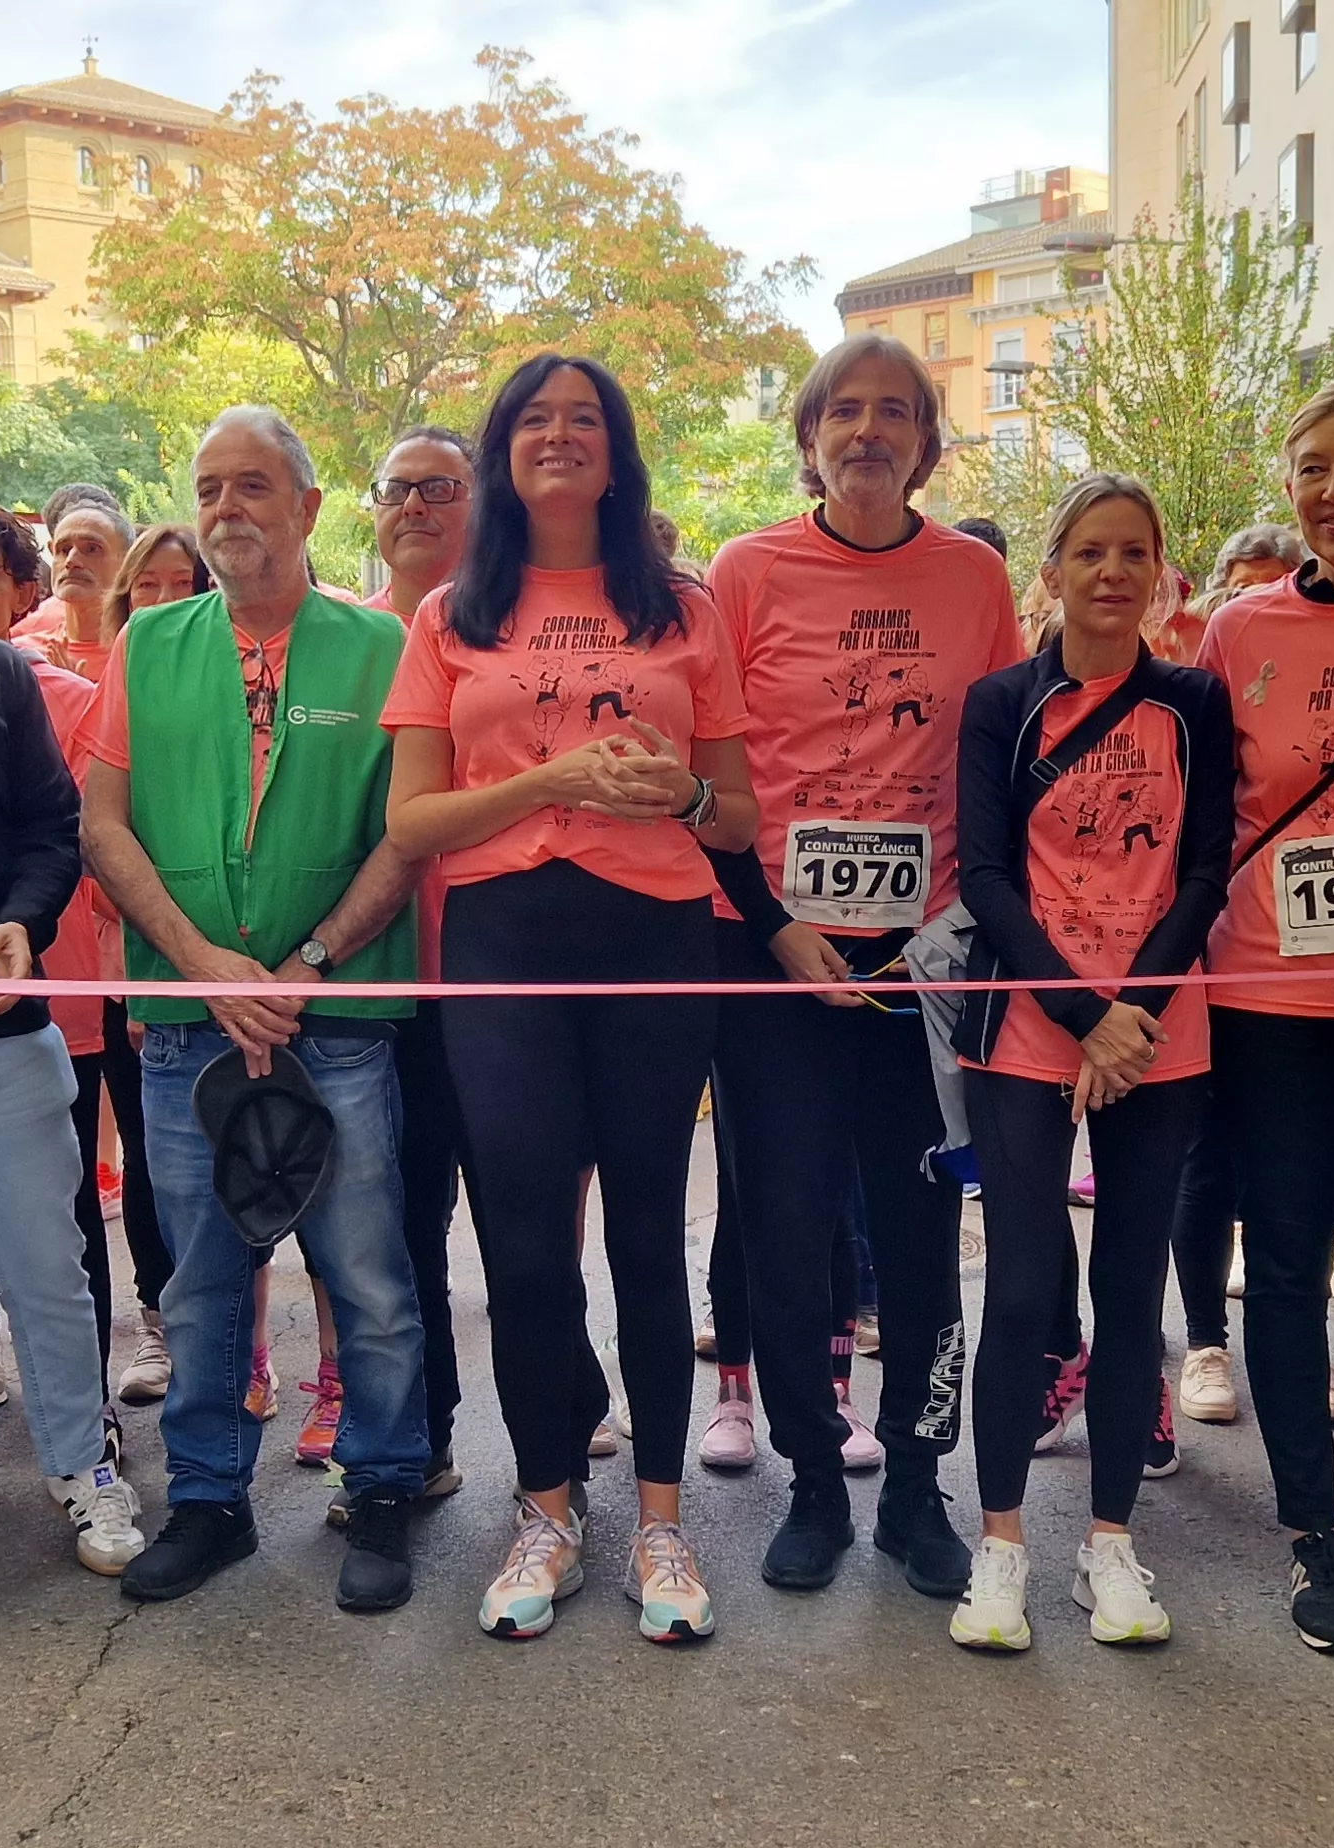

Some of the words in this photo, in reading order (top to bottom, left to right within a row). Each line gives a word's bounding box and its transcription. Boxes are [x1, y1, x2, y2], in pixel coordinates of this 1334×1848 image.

[542, 616, 608, 634] CORRAMOS
[850, 609, 912, 630] CORRAMOS
[528, 635, 552, 651] POR
[554, 634, 567, 650] LA
[571, 634, 617, 650] CIENCIA
[838, 631, 860, 651] POR
[862, 631, 874, 650] LA
[877, 630, 920, 650] CIENCIA
[1308, 690, 1332, 713] POR
[1066, 755, 1087, 776] OR
[1090, 756, 1102, 773] LA
[1106, 748, 1147, 771] CIENCIA
[804, 841, 855, 853] CONTRA
[857, 843, 870, 853] EL
[872, 843, 917, 855] CÁNCER
[846, 834, 880, 843] HUESCA
[802, 858, 917, 898] 1970
